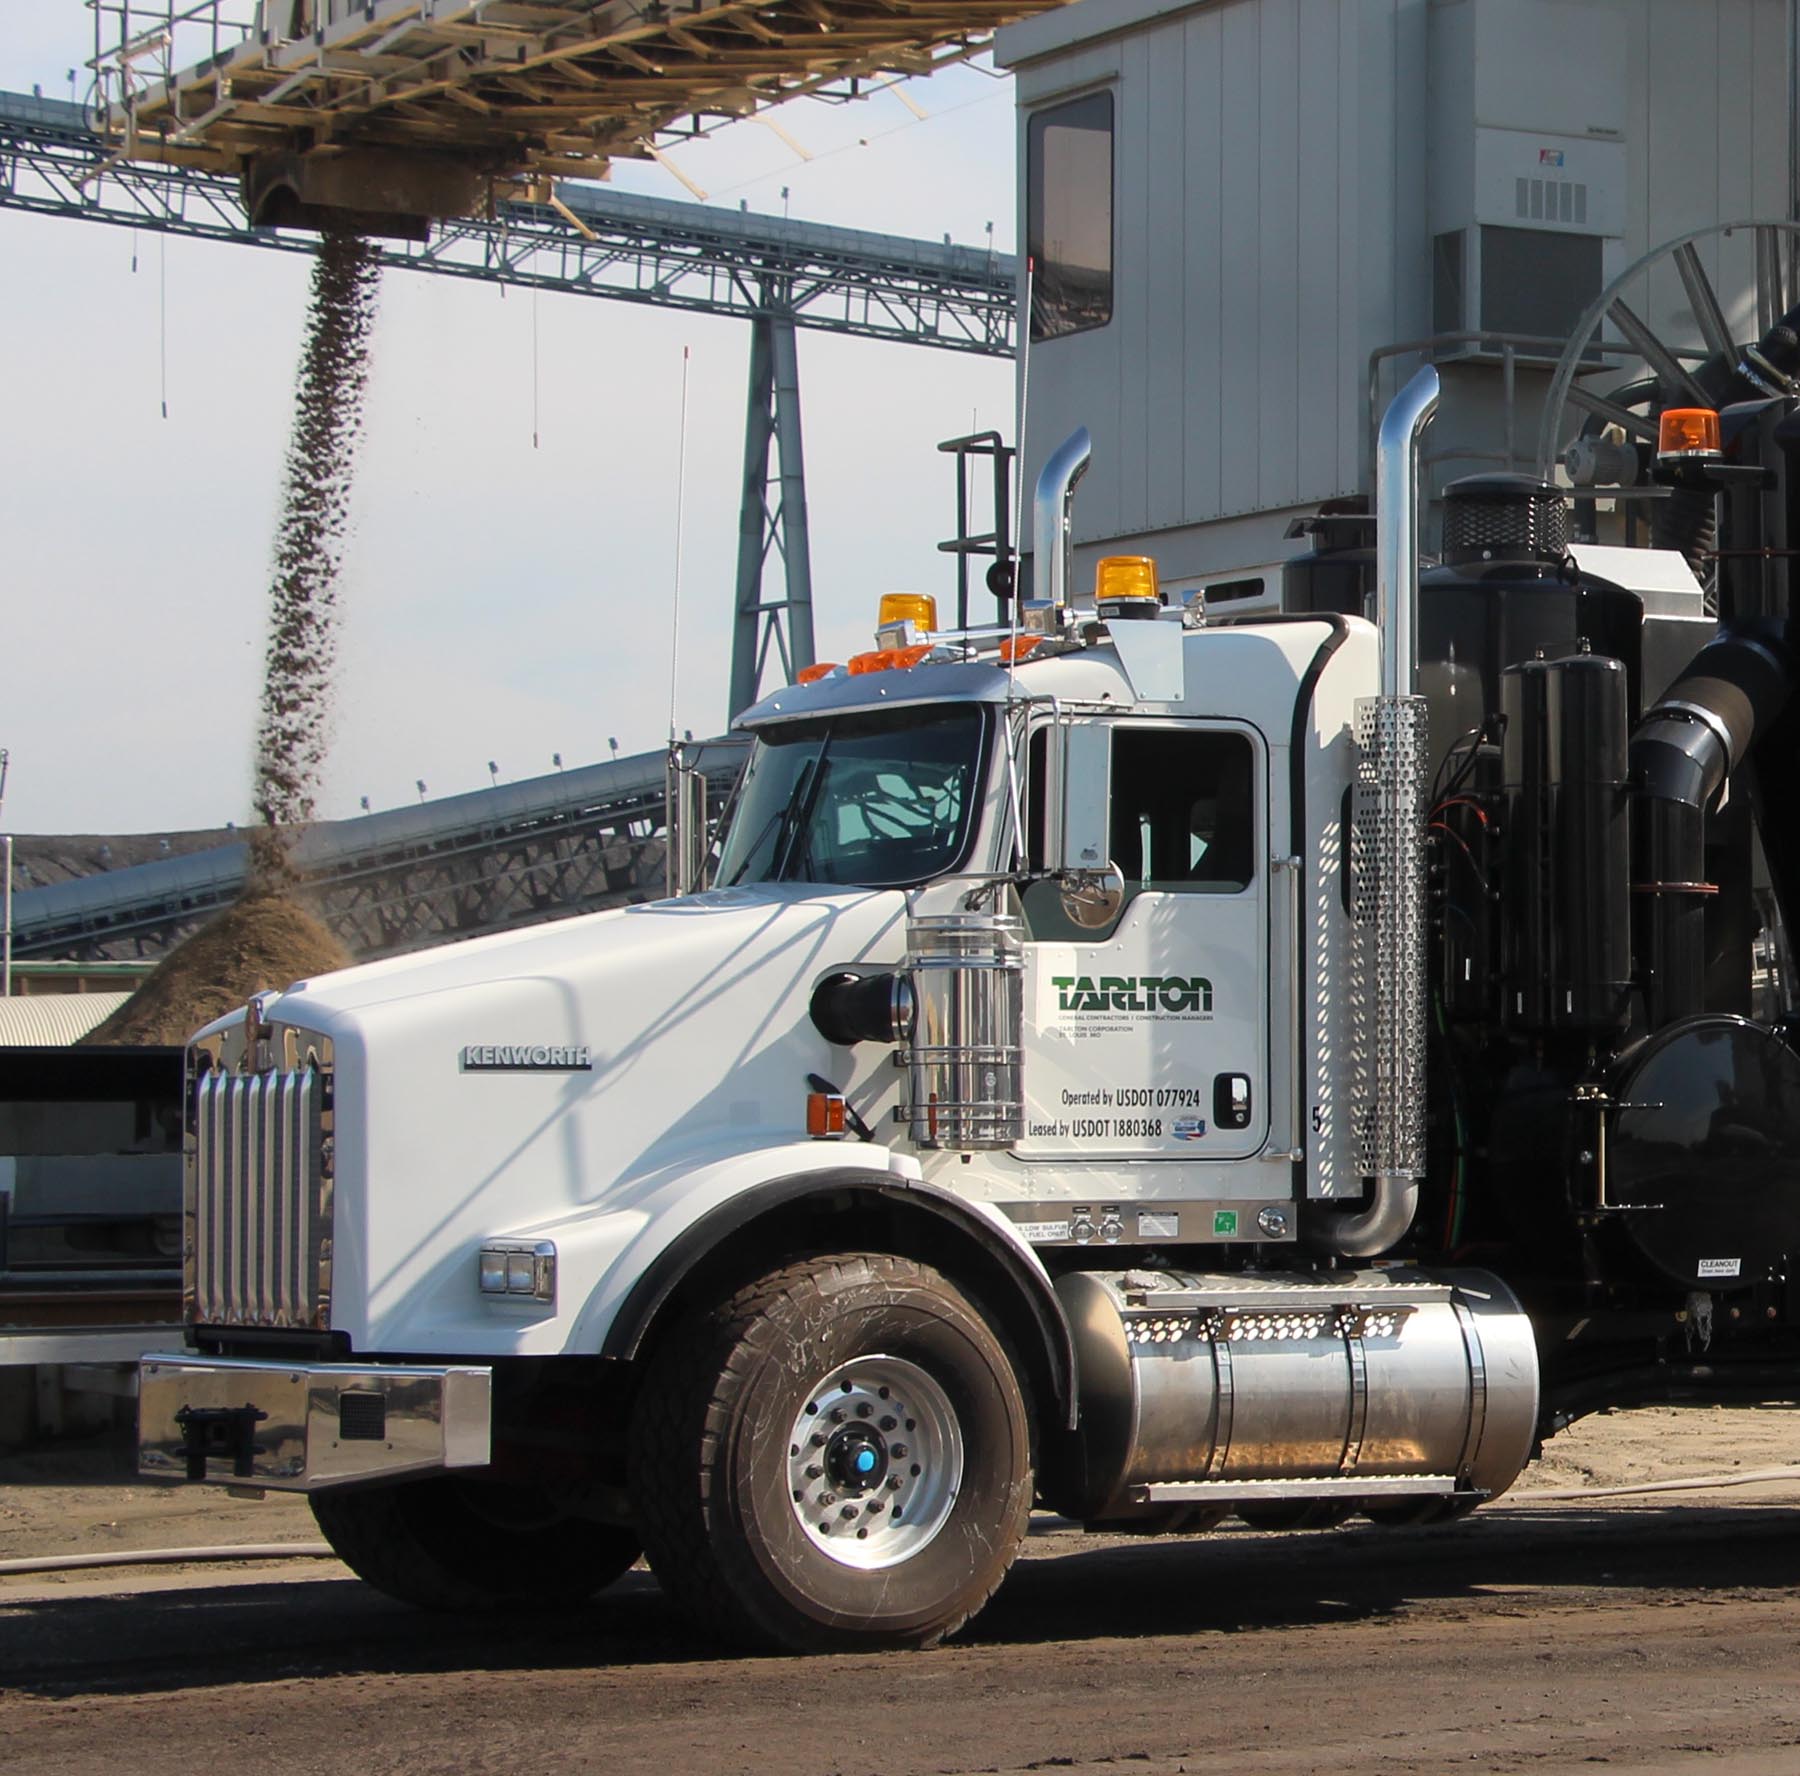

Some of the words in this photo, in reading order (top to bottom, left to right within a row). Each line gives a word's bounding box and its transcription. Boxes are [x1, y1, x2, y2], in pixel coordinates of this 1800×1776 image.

[1051, 976, 1213, 1012] TARLTON
[464, 1045, 592, 1065] KENWORTH
[1061, 1089, 1100, 1106] Operated
[1102, 1089, 1113, 1107] by
[1116, 1089, 1154, 1106] USDOT
[1156, 1089, 1200, 1106] 077924
[1028, 1120, 1057, 1136] Leased
[1059, 1120, 1070, 1137] by
[1072, 1120, 1110, 1137] USDOT
[1113, 1120, 1162, 1137] 1880368
[1700, 1260, 1738, 1268] CLEANOUT
